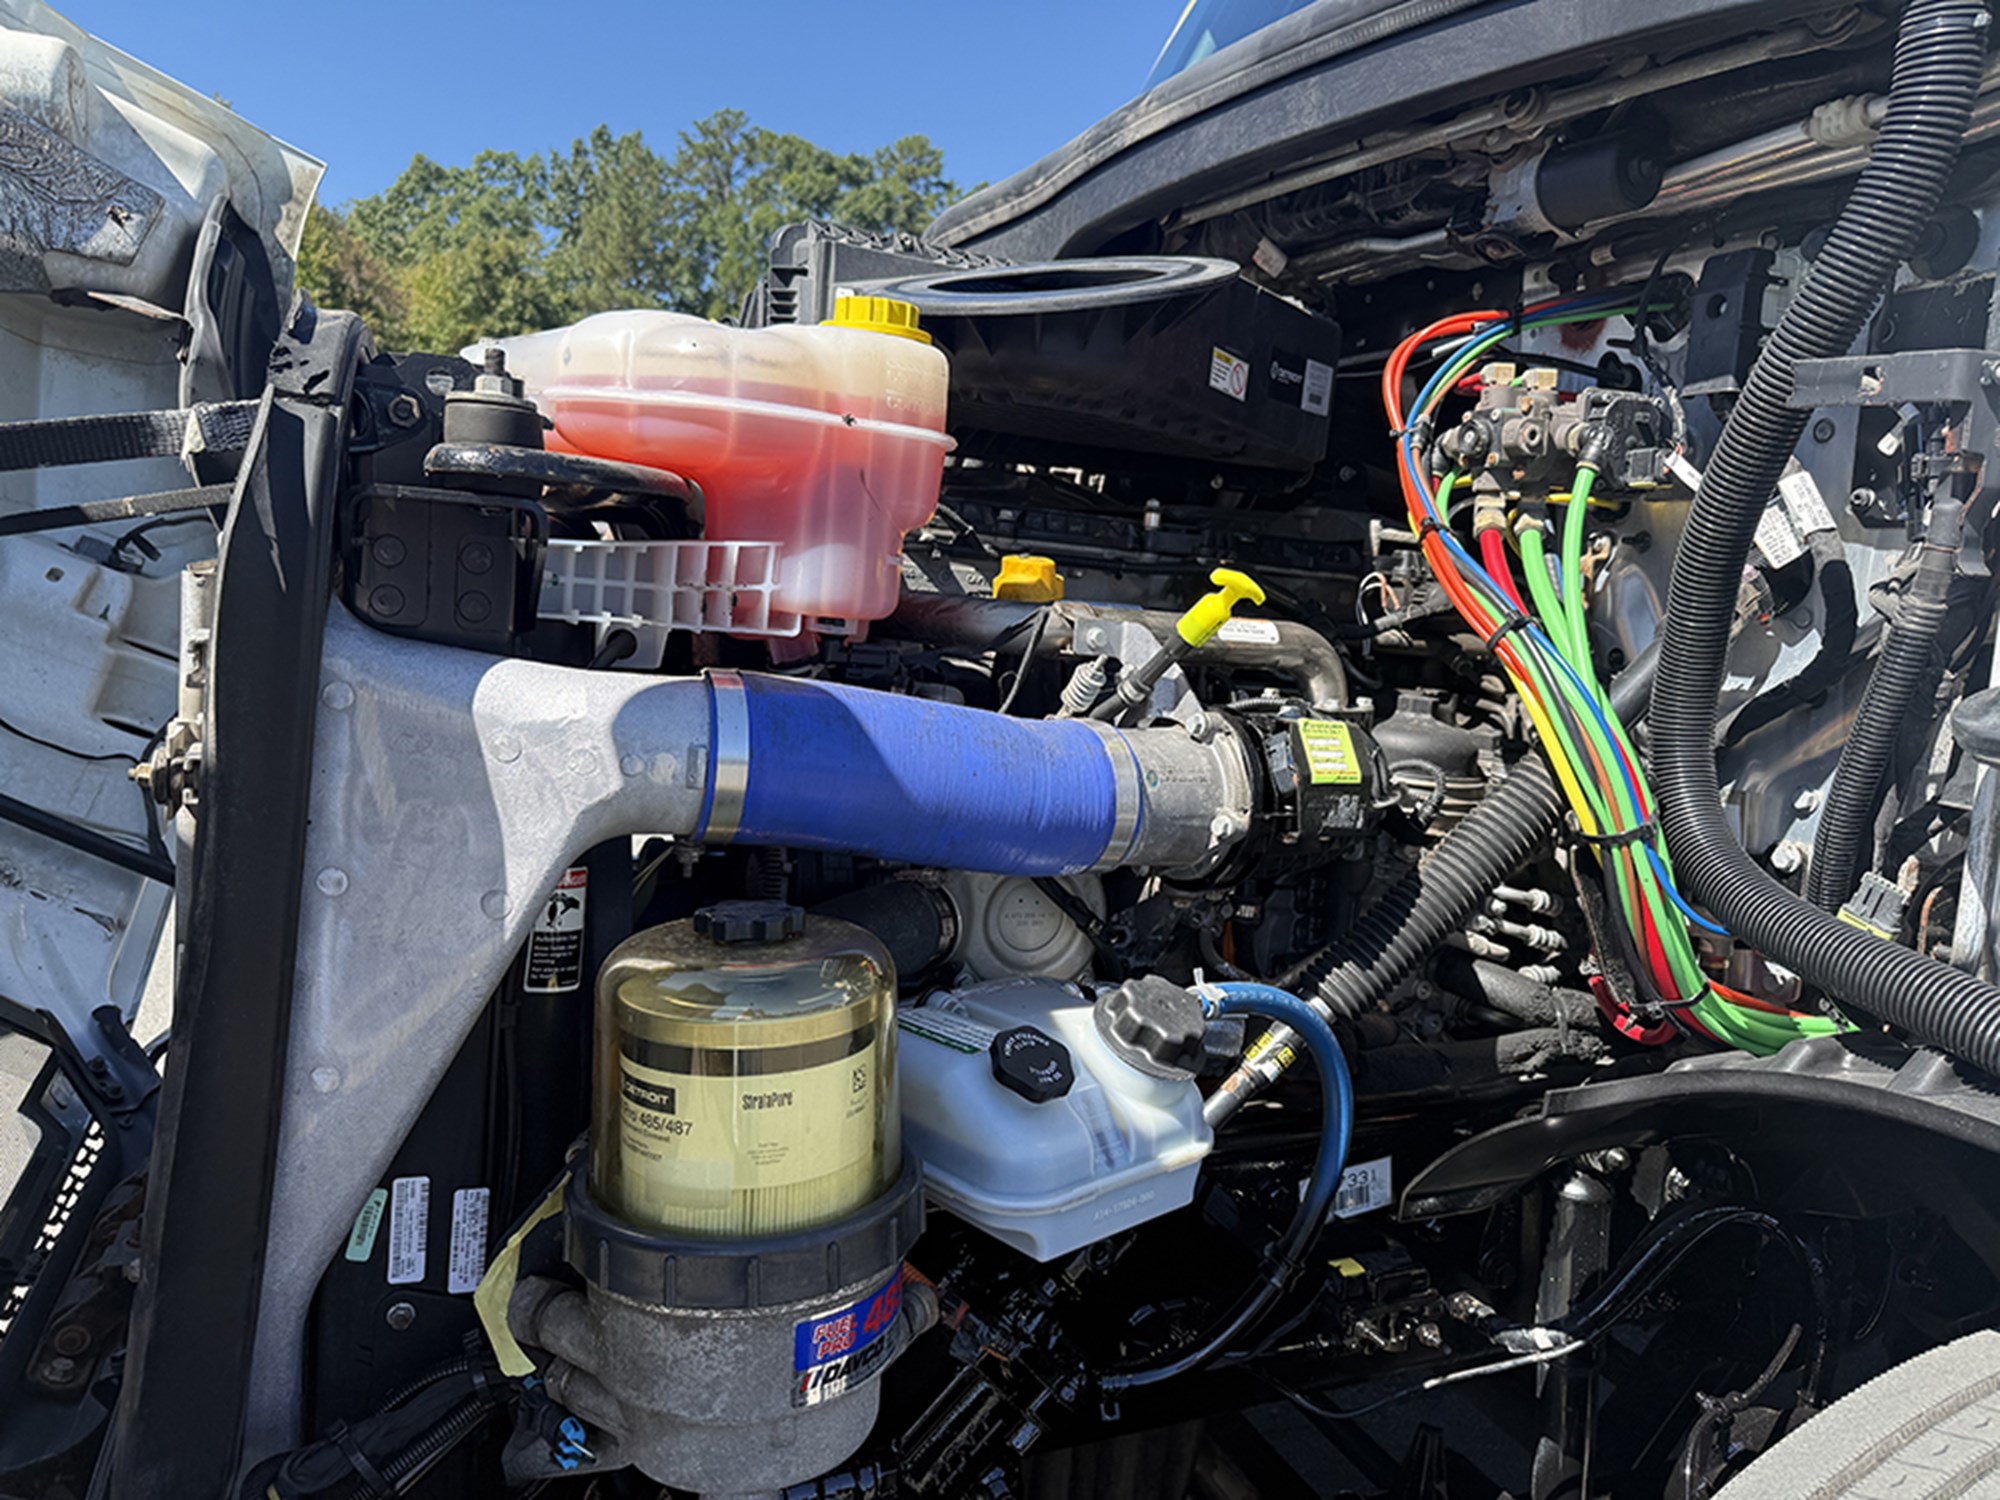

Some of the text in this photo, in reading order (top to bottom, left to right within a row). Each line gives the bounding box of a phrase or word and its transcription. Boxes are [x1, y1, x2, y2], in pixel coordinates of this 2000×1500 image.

[640, 1112, 693, 1136] 485/487
[813, 1314, 857, 1344] FUEL
[817, 1331, 856, 1360] PRO
[822, 1334, 886, 1385] DAVCO
